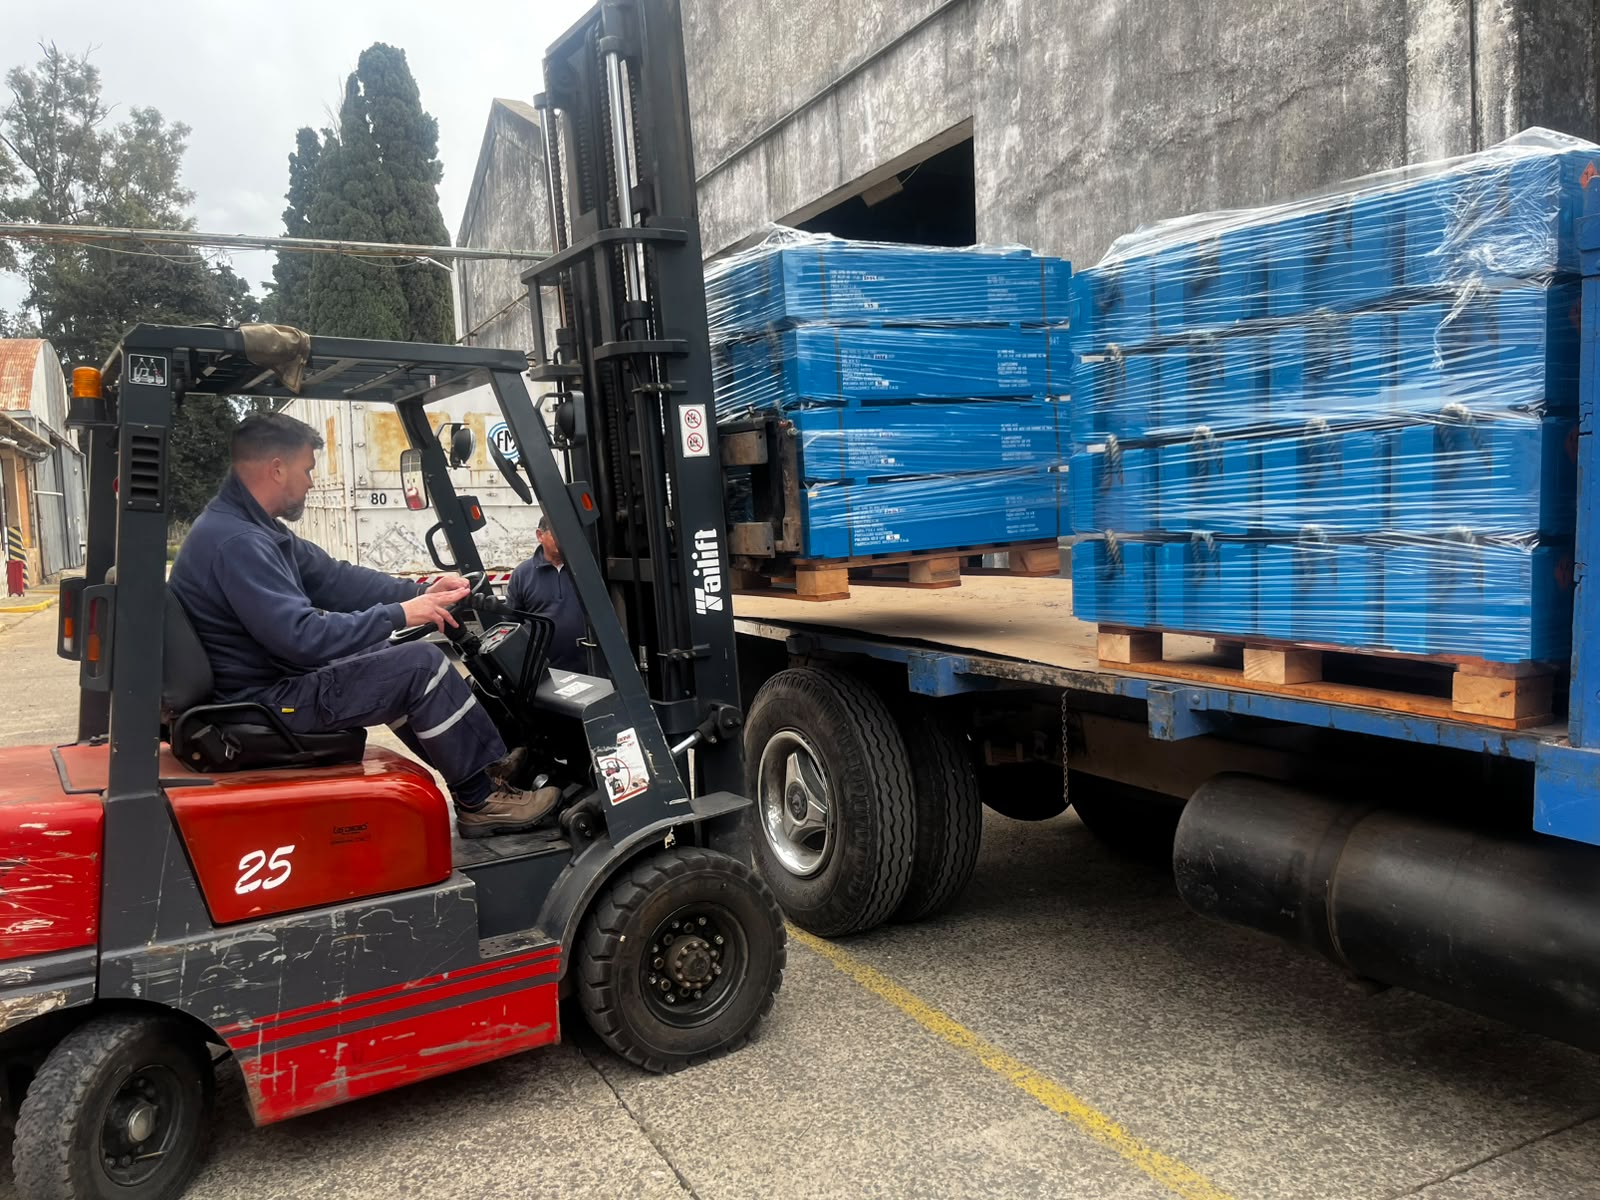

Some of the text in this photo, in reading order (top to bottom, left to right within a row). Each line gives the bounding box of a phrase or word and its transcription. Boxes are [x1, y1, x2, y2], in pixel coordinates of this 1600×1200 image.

[371, 492, 387, 505] 80
[691, 528, 723, 615] Tailift
[234, 844, 296, 895] 25
